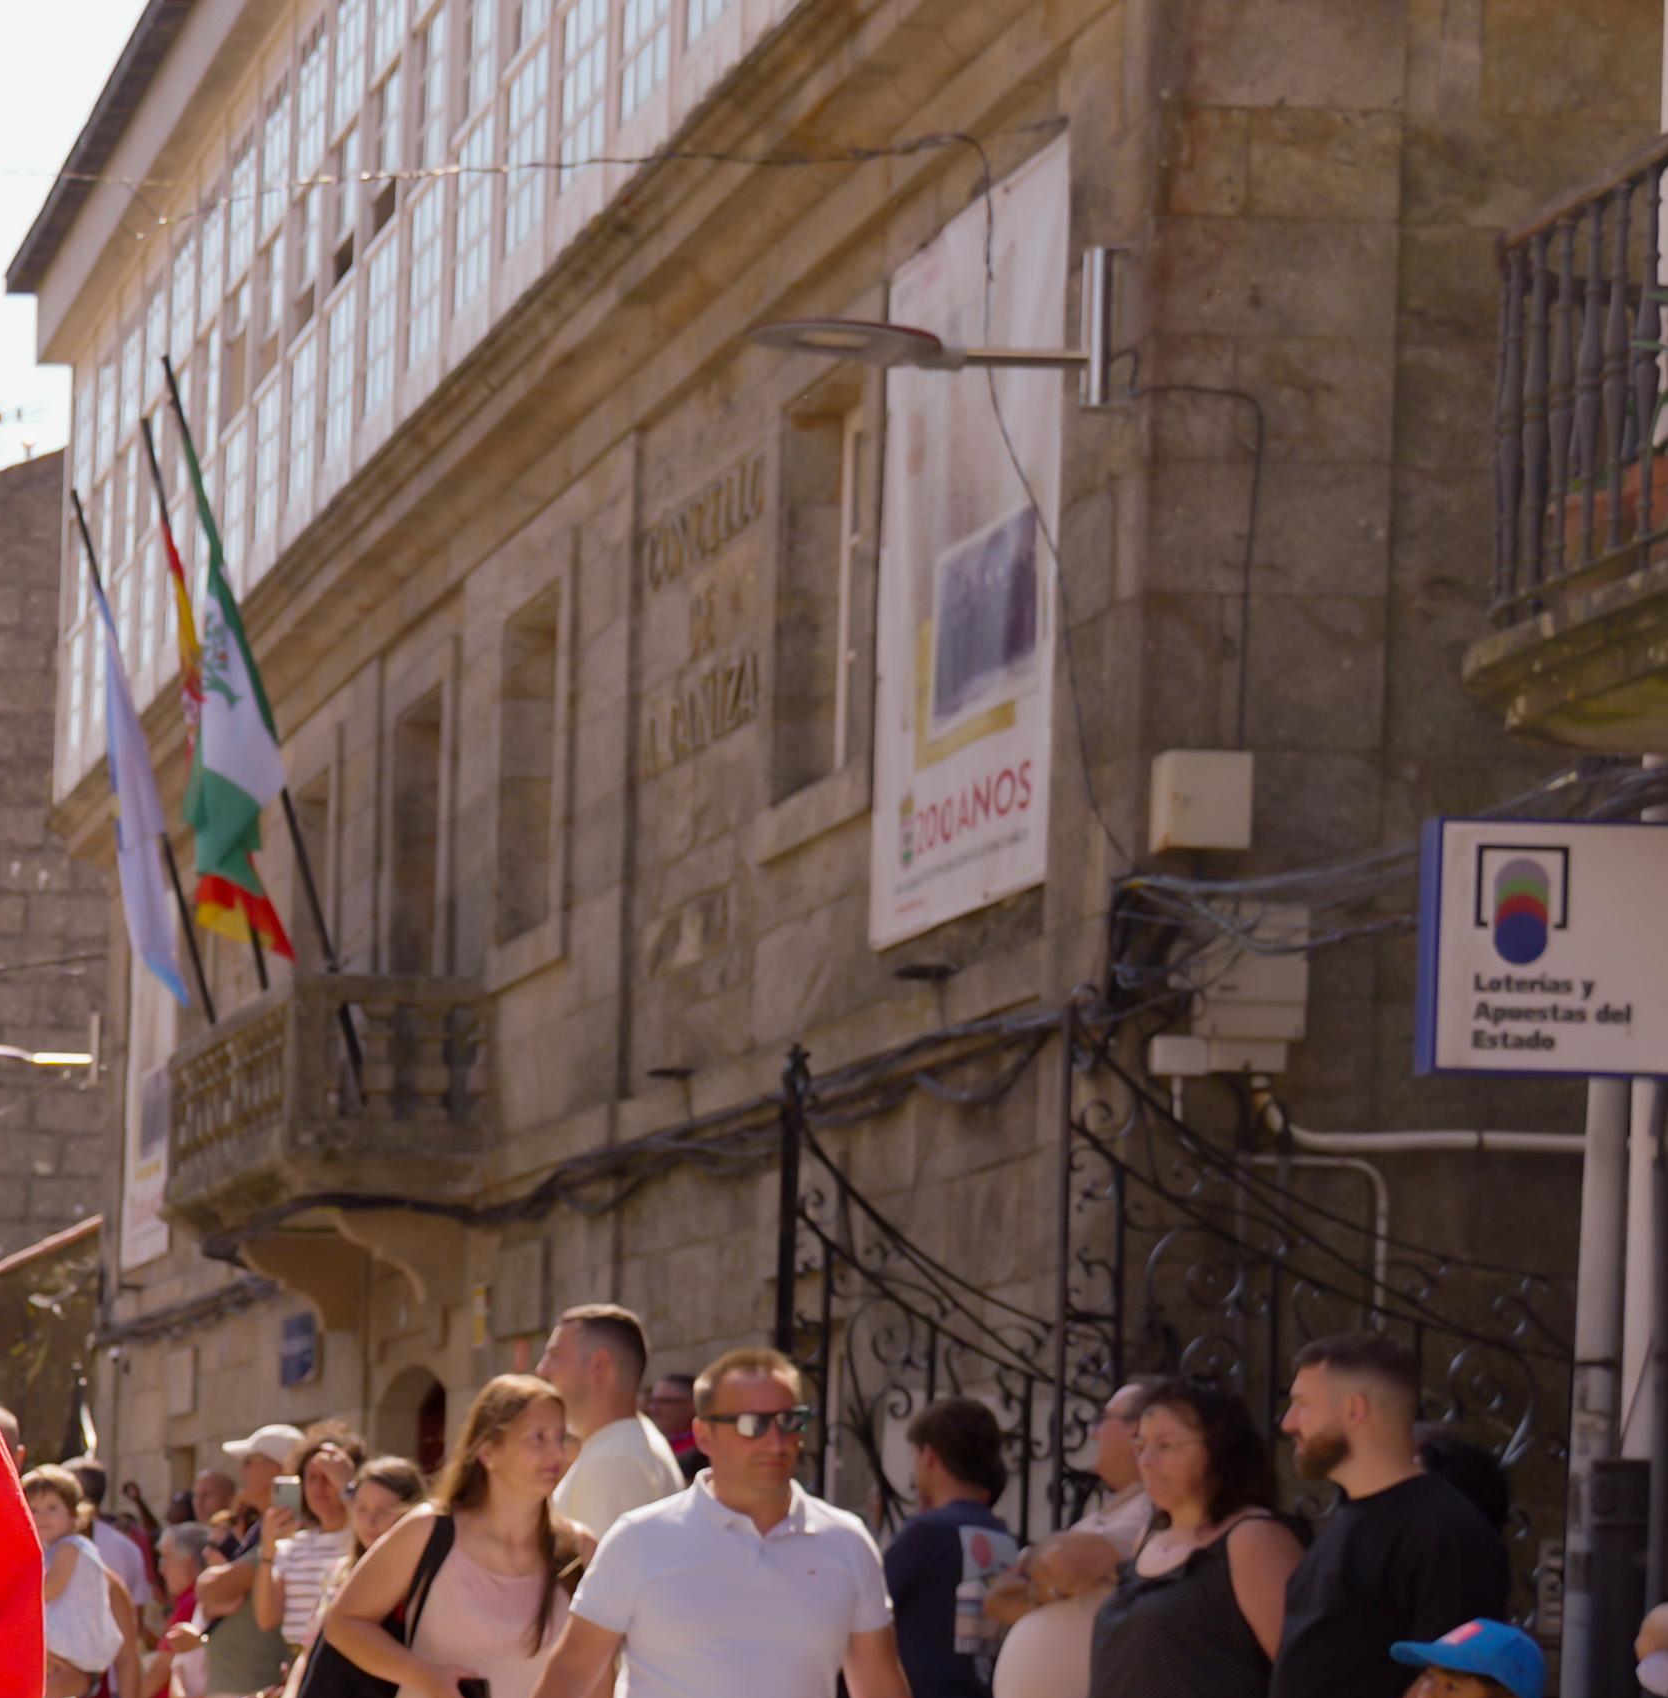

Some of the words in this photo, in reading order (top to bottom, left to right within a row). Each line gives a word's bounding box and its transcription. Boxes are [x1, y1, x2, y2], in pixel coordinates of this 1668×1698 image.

[1473, 972, 1573, 994] Loterías
[1581, 978, 1595, 998] y
[1473, 1001, 1587, 1024] Apuestas
[1596, 1004, 1632, 1024] del
[1472, 1030, 1555, 1050] Estado
